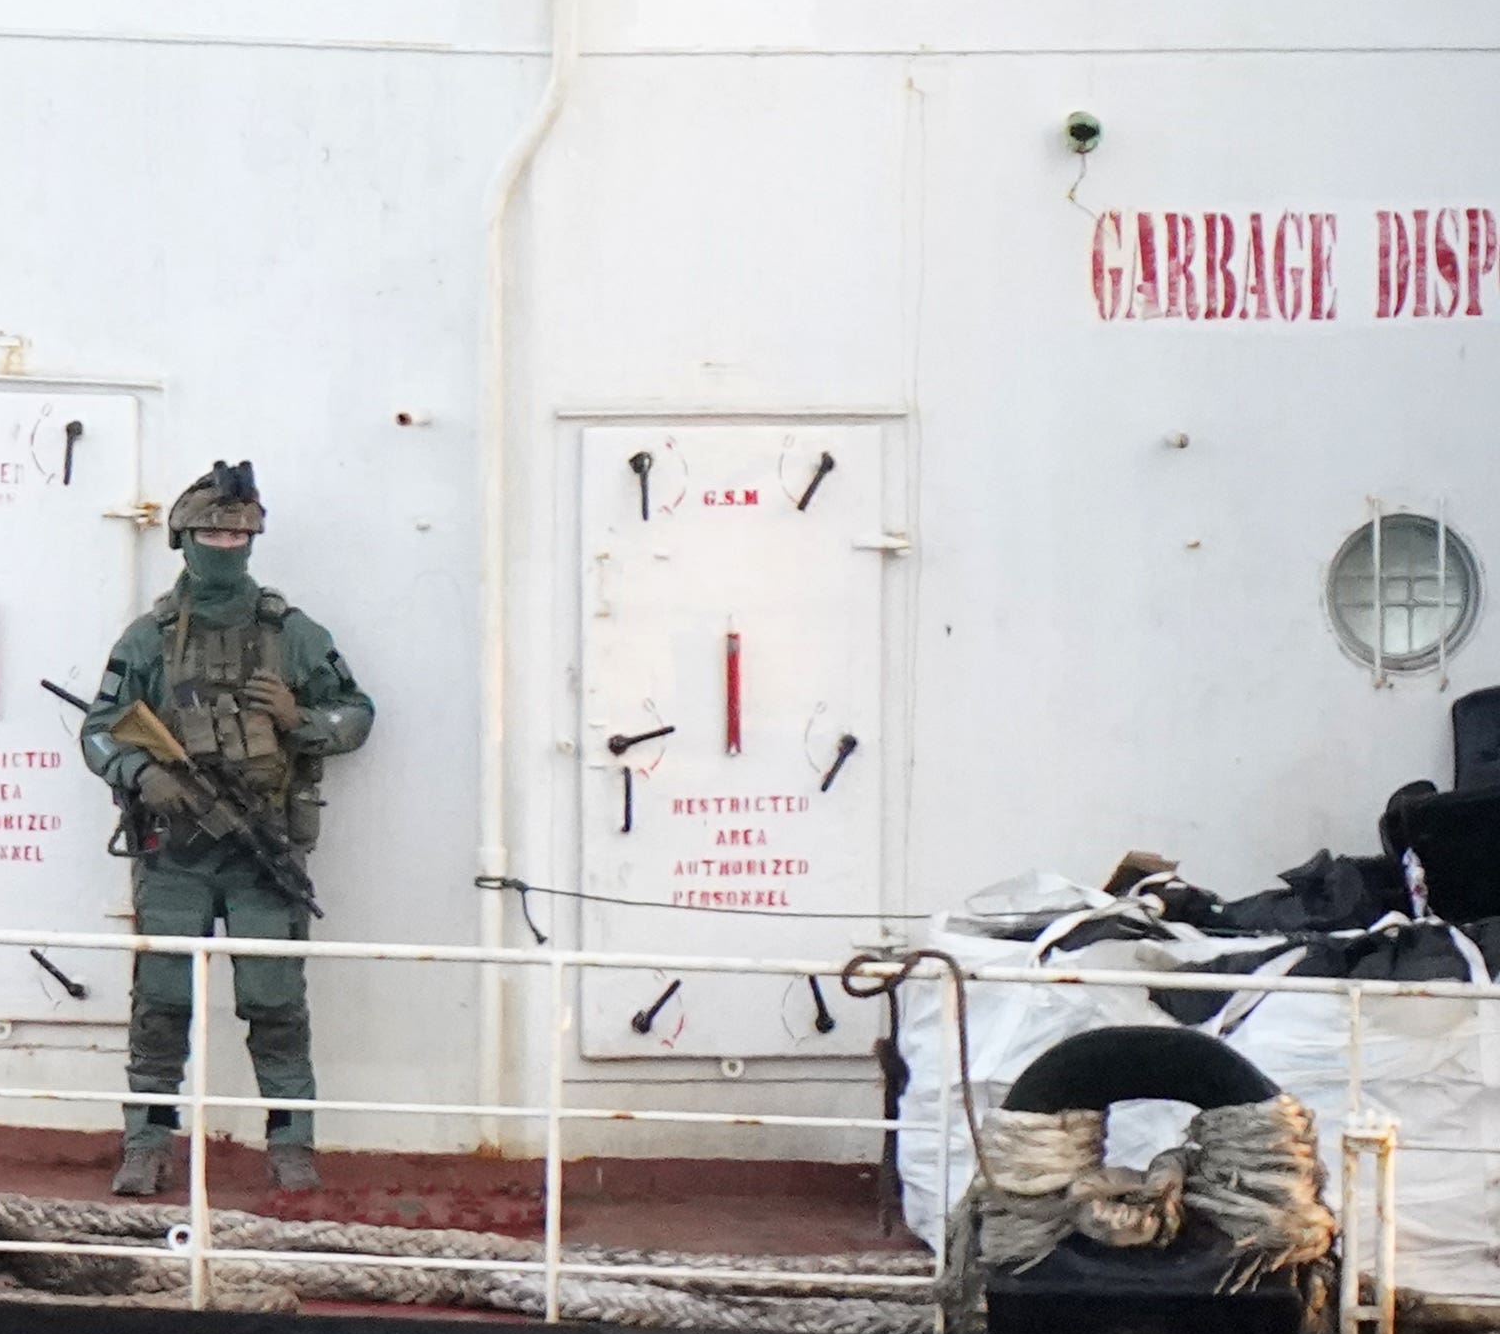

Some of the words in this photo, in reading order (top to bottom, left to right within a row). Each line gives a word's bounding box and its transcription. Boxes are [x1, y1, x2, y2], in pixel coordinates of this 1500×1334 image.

[1091, 210, 1338, 322] GARBAGE
[1375, 208, 1500, 318] DISP
[673, 796, 810, 815] RESTRICTED
[715, 829, 767, 846] AREA
[673, 859, 810, 876] AUTHORIZED
